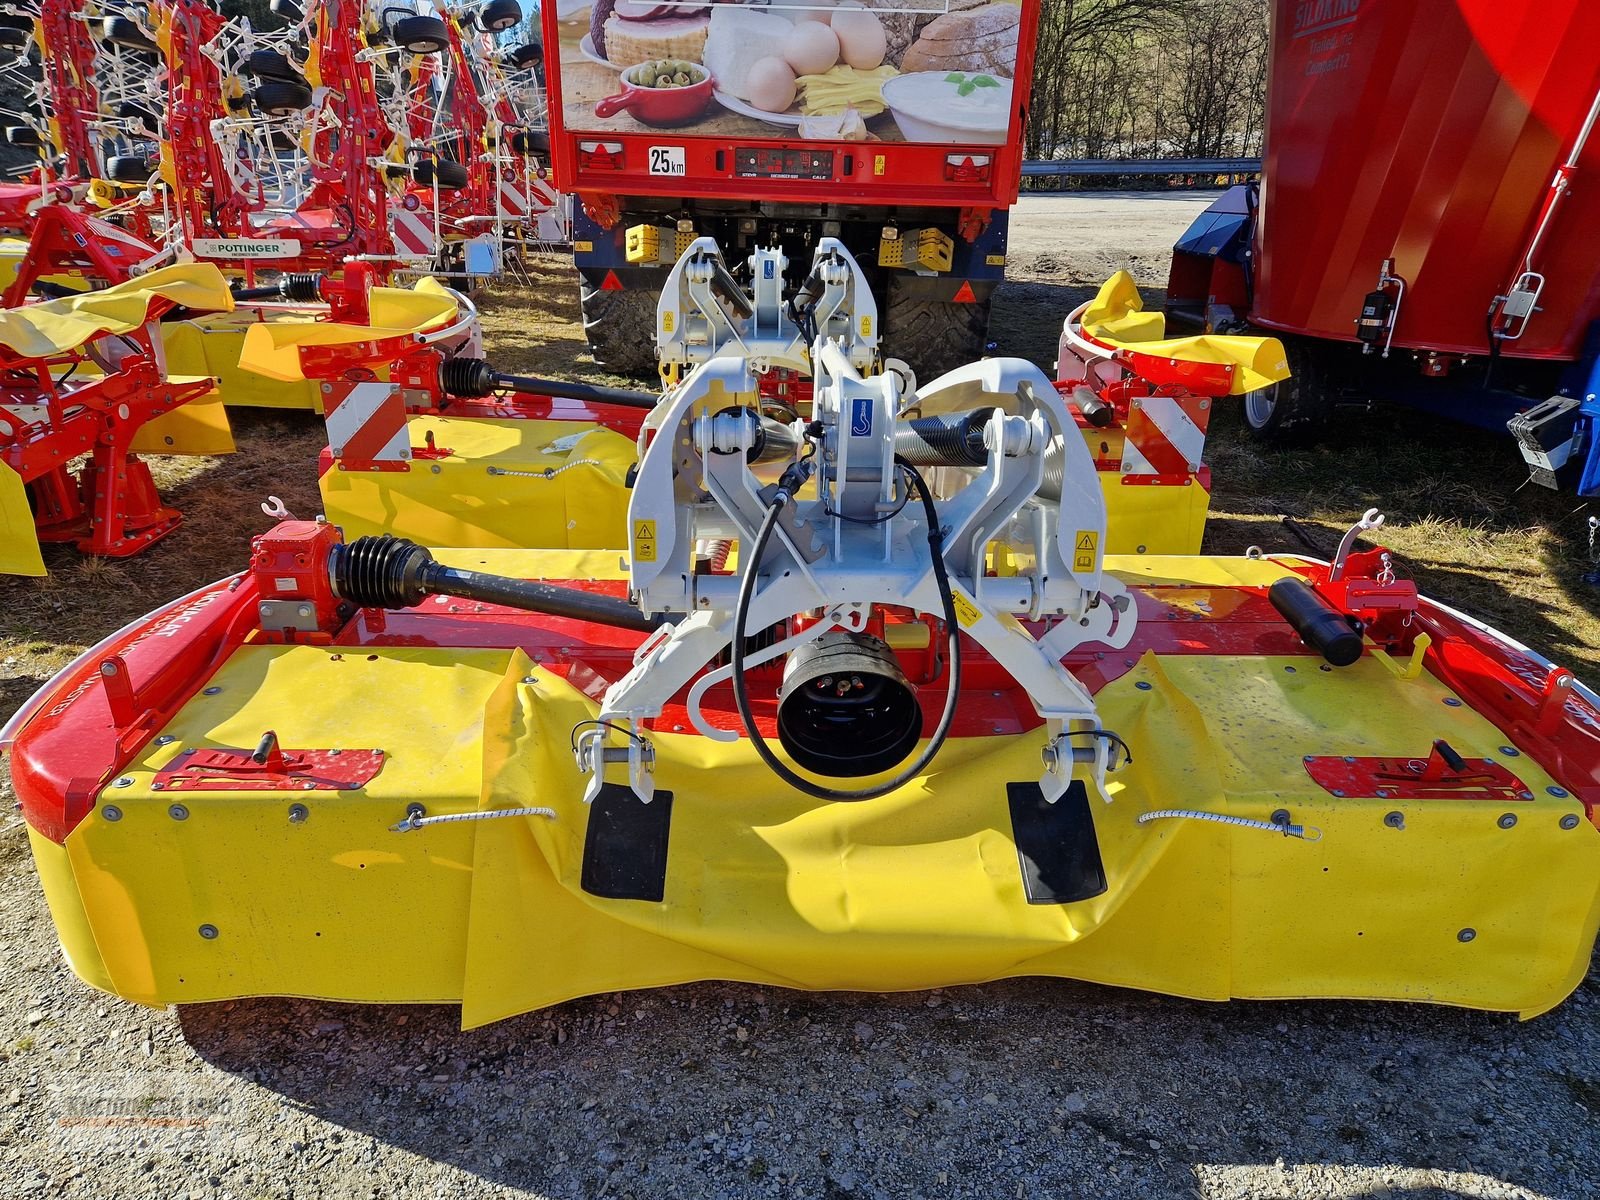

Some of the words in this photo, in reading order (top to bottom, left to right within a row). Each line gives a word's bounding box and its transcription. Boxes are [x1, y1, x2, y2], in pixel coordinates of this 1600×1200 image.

[651, 149, 670, 173] 25
[671, 160, 684, 173] km
[154, 589, 225, 637] NOVACAT
